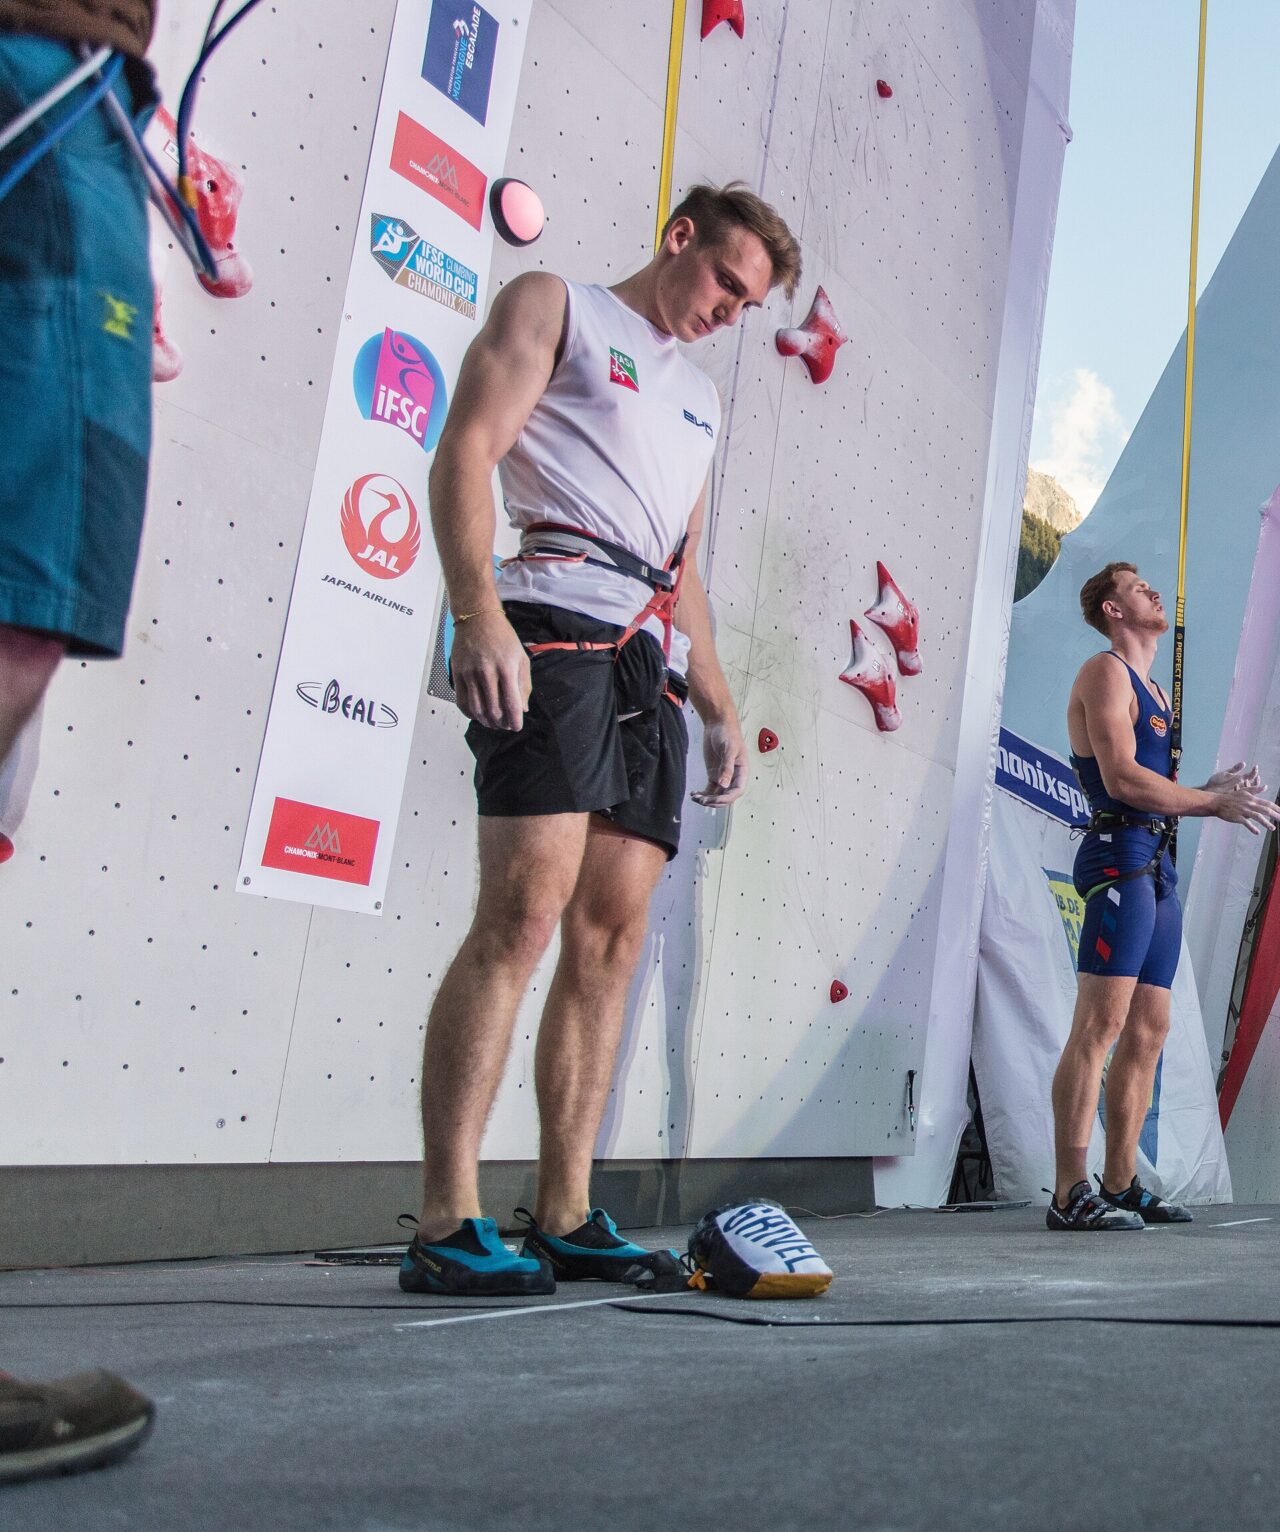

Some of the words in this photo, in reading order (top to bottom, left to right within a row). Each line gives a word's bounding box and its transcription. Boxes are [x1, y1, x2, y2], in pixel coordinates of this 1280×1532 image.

[465, 6, 481, 69] ESCALADE
[451, 36, 469, 100] MONTAGNE
[421, 241, 444, 267] IFSC
[408, 272, 456, 310] CHAMONIX
[458, 298, 476, 320] 2018
[415, 255, 453, 289] WORLD
[454, 276, 475, 301] CUP
[357, 544, 400, 574] JAL
[321, 574, 361, 594] JAPAN
[363, 590, 414, 616] AIRLINES
[1174, 641, 1183, 679] PERFECT
[322, 679, 376, 727] BEAL
[1173, 682, 1182, 719] DESCENT
[723, 1204, 820, 1274] GRIVEL
